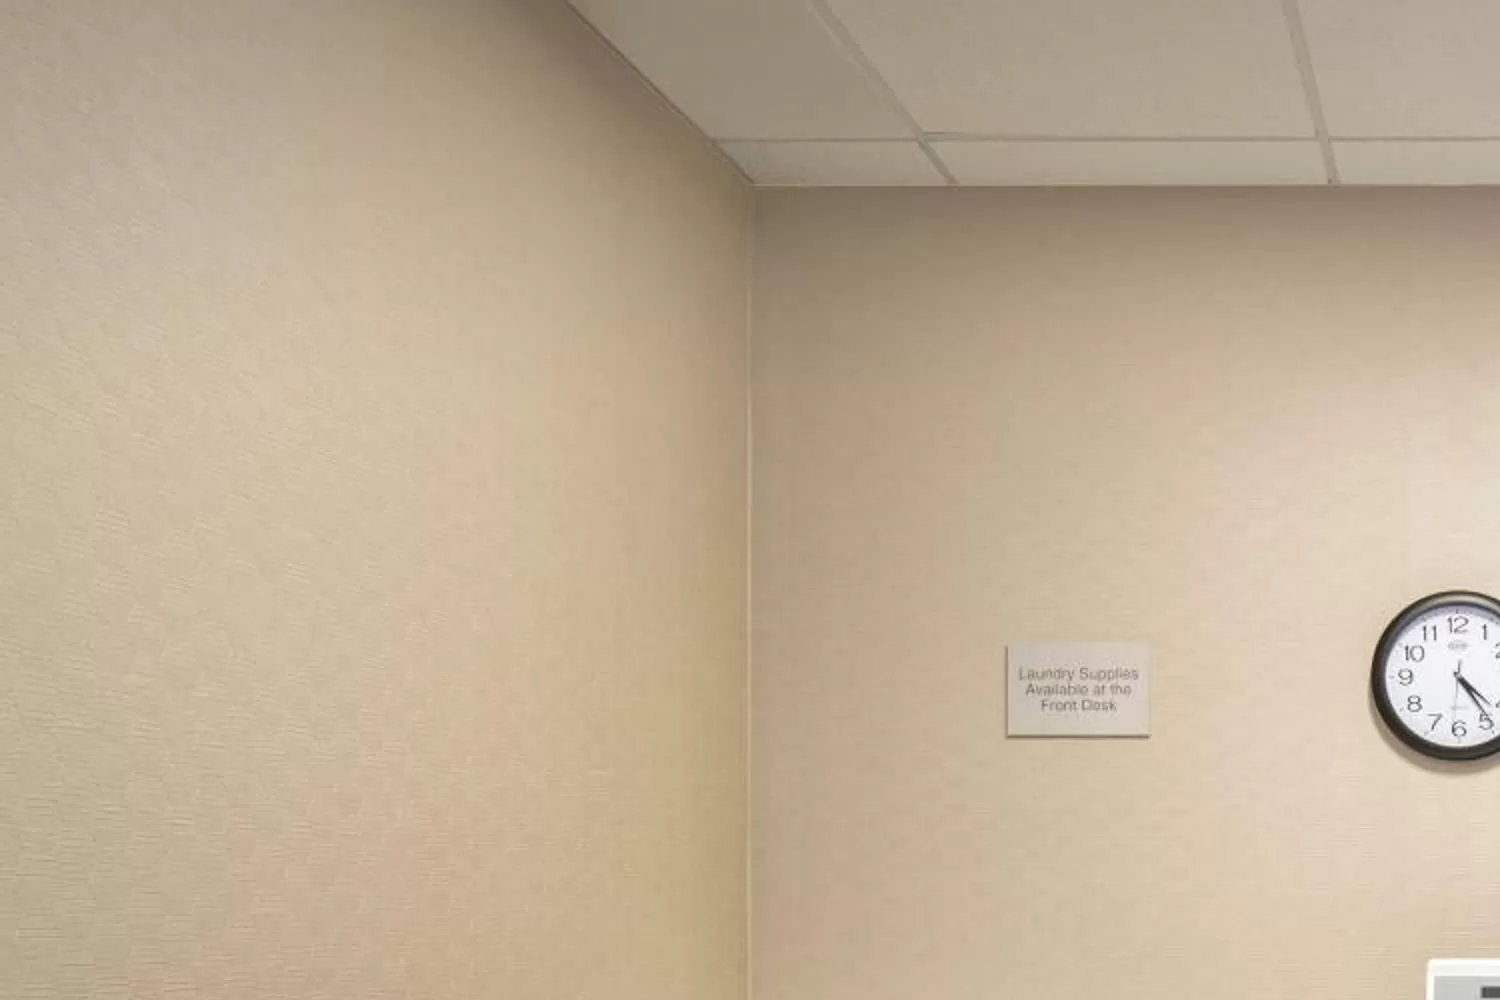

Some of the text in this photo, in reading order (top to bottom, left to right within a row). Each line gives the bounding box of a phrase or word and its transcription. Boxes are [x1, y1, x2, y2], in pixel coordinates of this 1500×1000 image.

[1422, 624, 1438, 641] 11
[1447, 615, 1469, 634] 12
[1404, 644, 1425, 662] 10
[1018, 667, 1139, 681] Laundry Supplies
[1397, 668, 1414, 686] 9
[1025, 683, 1132, 696] Available at the
[1040, 699, 1117, 712] Front Desk
[1406, 695, 1423, 712] 8
[1427, 713, 1443, 731] 7
[1450, 719, 1468, 738] 6
[1478, 713, 1495, 731] 5
